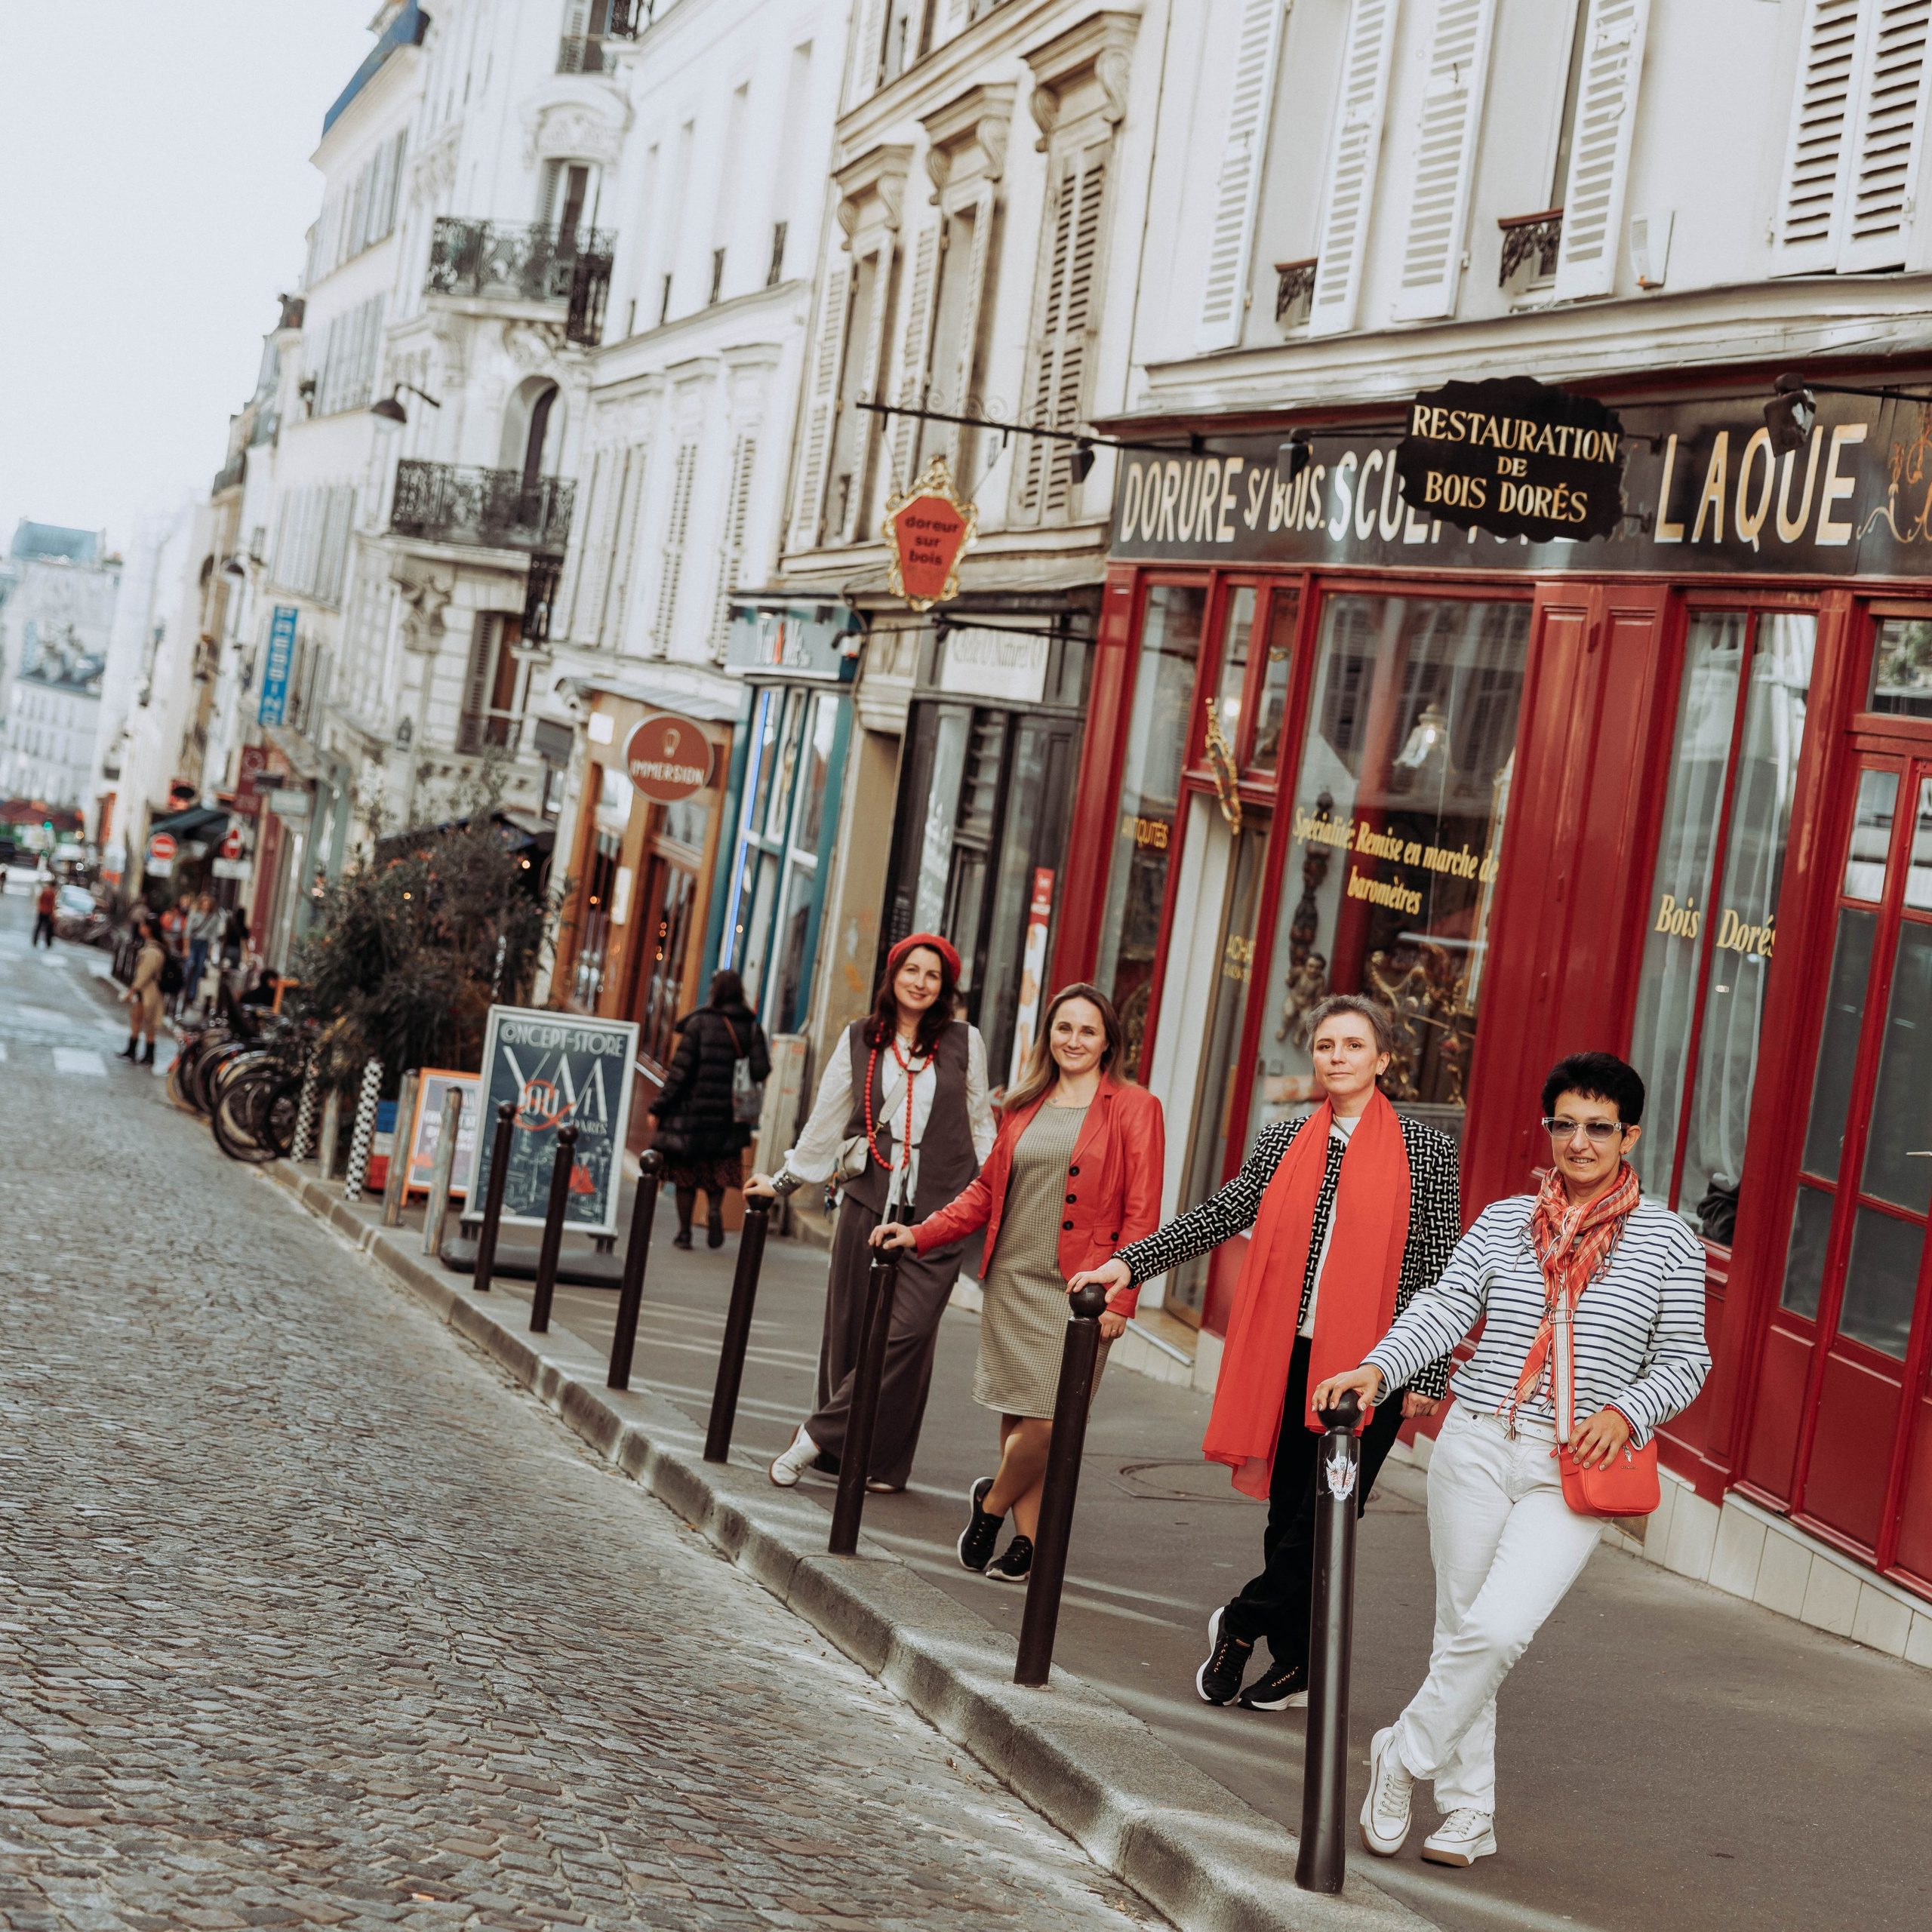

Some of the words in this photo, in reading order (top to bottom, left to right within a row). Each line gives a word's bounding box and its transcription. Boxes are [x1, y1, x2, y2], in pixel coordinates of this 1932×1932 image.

[1411, 405, 1619, 463] RESTAURATION
[1497, 456, 1527, 477] DE
[1654, 423, 1868, 552] LAQUE
[1120, 457, 1244, 543] DORURE
[1424, 471, 1487, 509] BOIS
[1498, 481, 1588, 523] DORÉS
[905, 515, 958, 533] doreur
[915, 536, 940, 547] sur
[909, 549, 943, 565] bois
[630, 759, 705, 786] IMMERSION
[1355, 821, 1404, 862] Remise
[1404, 841, 1422, 866] en
[1423, 844, 1478, 879] marche
[1479, 849, 1500, 884] de
[1347, 865, 1423, 915] baromètres
[1654, 894, 1701, 939] Bois
